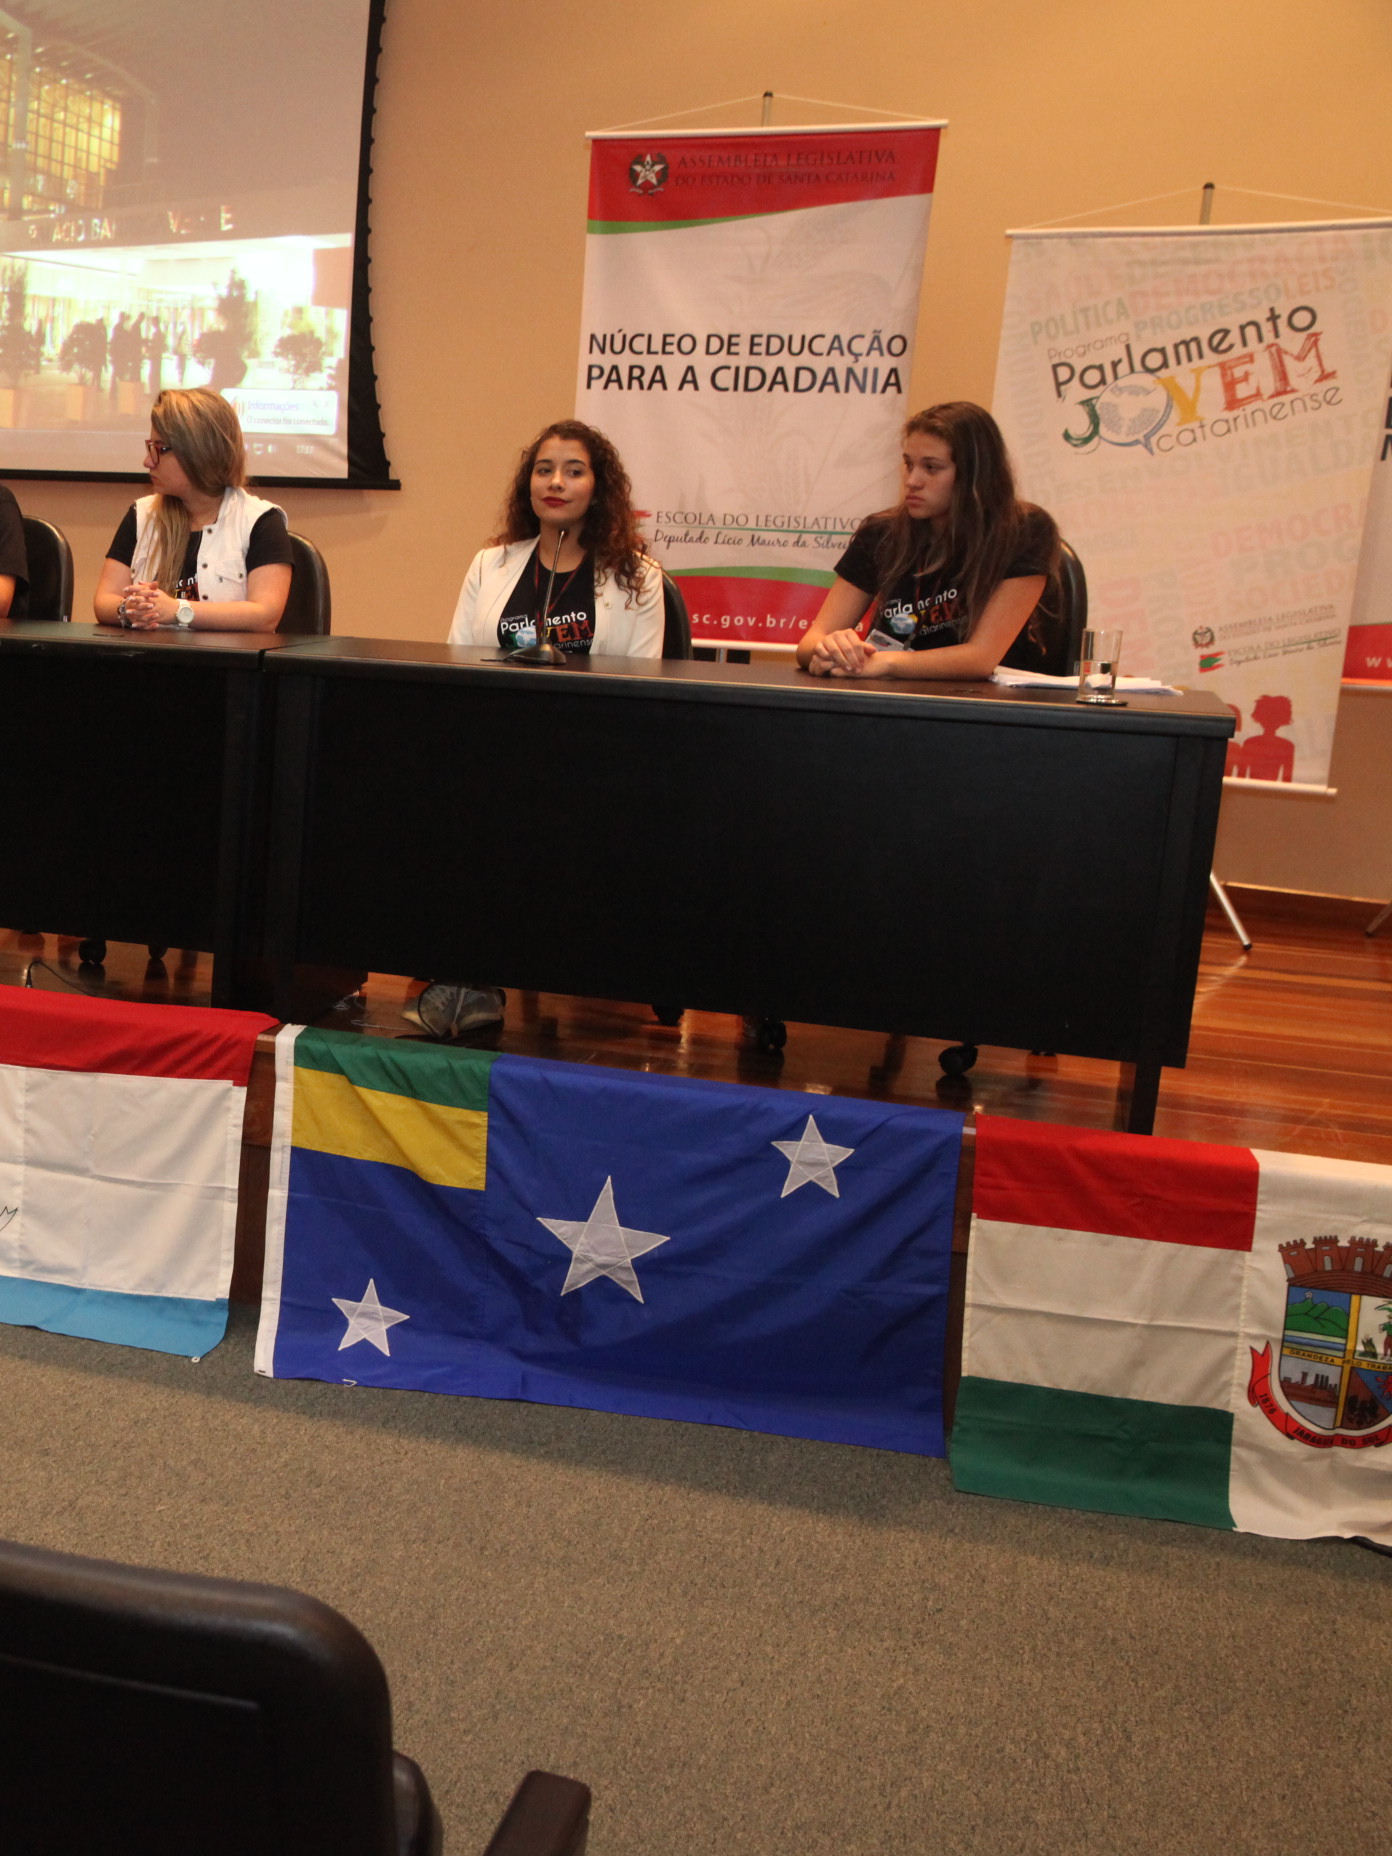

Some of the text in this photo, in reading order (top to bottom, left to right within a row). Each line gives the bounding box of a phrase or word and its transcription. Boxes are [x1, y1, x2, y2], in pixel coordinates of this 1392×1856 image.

[785, 149, 897, 166] LEGISLATIVA
[588, 328, 908, 363] NÚCLEO DE EDUCAÇÃO
[1048, 330, 1130, 363] Programa
[1051, 304, 1317, 400] Parlamento
[585, 363, 904, 395] PARA A CIDADANIA
[1062, 331, 1338, 456] JOVEM
[1156, 386, 1344, 453] catarinense
[656, 510, 716, 526] ESCOLA
[722, 513, 748, 528] DO
[654, 529, 709, 550] Deputado
[746, 533, 788, 548] Mauro
[792, 534, 810, 549] da
[1289, 1349, 1335, 1364] GRANDEZA
